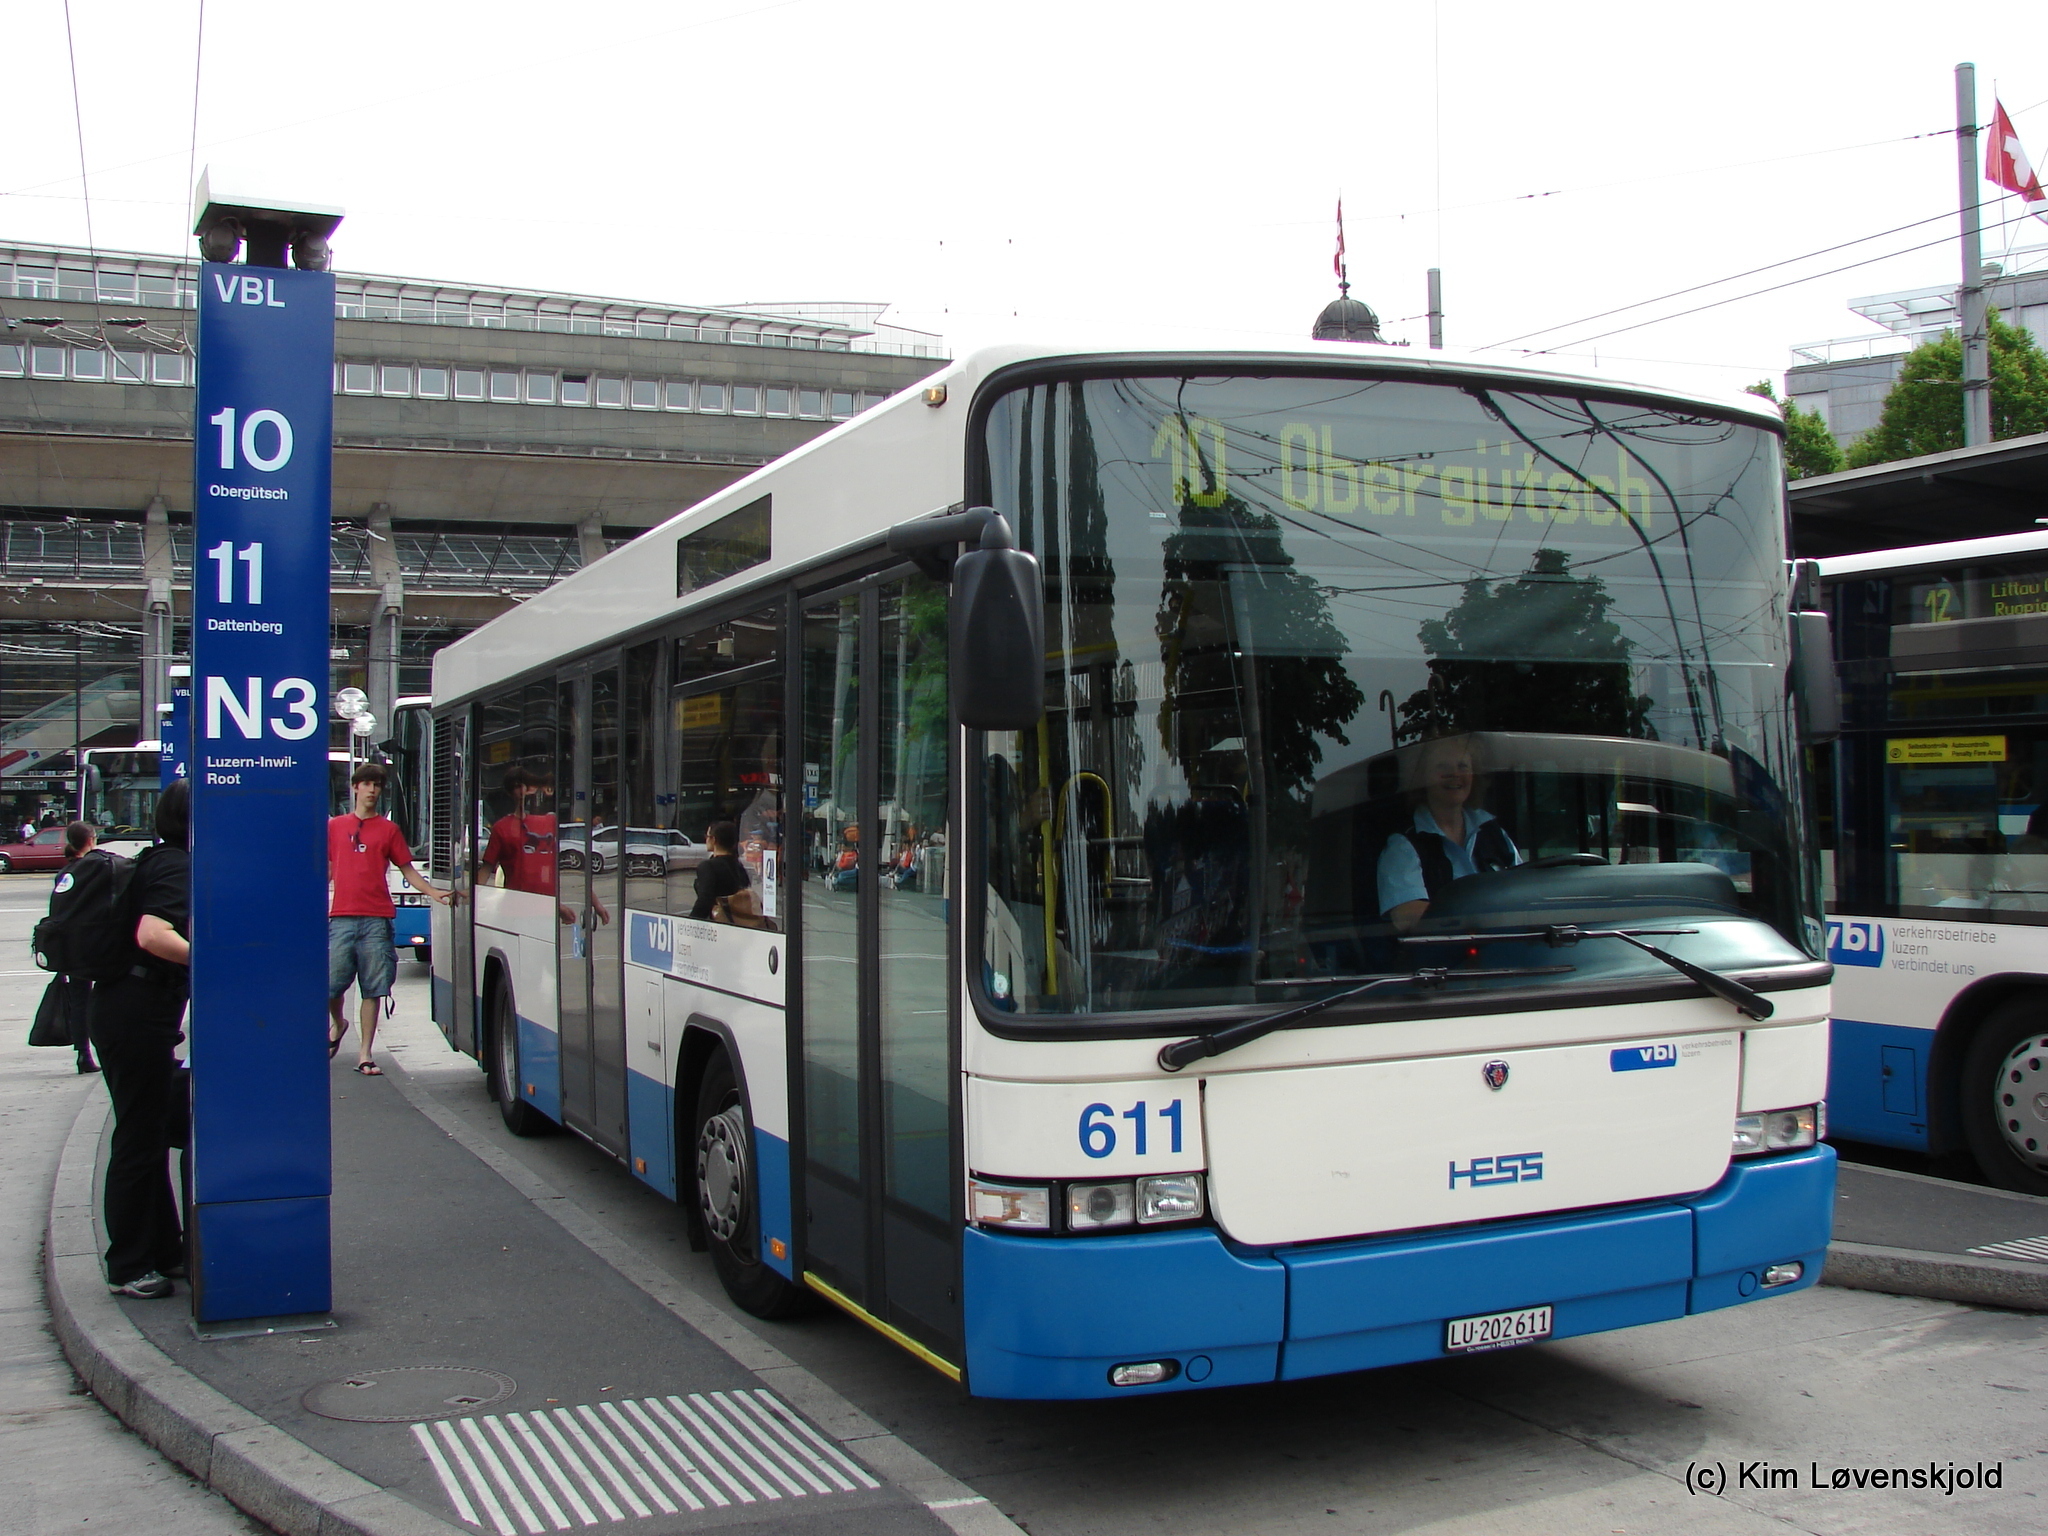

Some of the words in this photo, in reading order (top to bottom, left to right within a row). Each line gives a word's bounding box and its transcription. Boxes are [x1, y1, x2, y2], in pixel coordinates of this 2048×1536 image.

[214, 273, 286, 308] VBL
[210, 406, 295, 473] 10
[1151, 414, 1227, 508] 10
[1280, 422, 1651, 528] Obergütsch
[209, 483, 289, 501] Obergütsch
[208, 540, 263, 605] 11
[1990, 581, 2041, 598] Littau
[1924, 588, 1952, 623] 12
[207, 618, 284, 635] Dattenberg
[175, 689, 191, 697] VBL
[206, 675, 319, 741] N3
[162, 742, 174, 755] 14
[174, 762, 187, 777] 4
[207, 755, 298, 769] Luzern-Inwil-
[207, 772, 241, 785] Root
[648, 916, 672, 953] vbl
[1892, 925, 1997, 944] verkehrsbetriebe
[1892, 941, 1929, 956] luzern
[1891, 958, 1949, 974] verbindet
[1951, 961, 1976, 976] uns
[1639, 1043, 1675, 1062] vbl
[1078, 1098, 1182, 1159] 611
[1449, 1151, 1543, 1190] HESS
